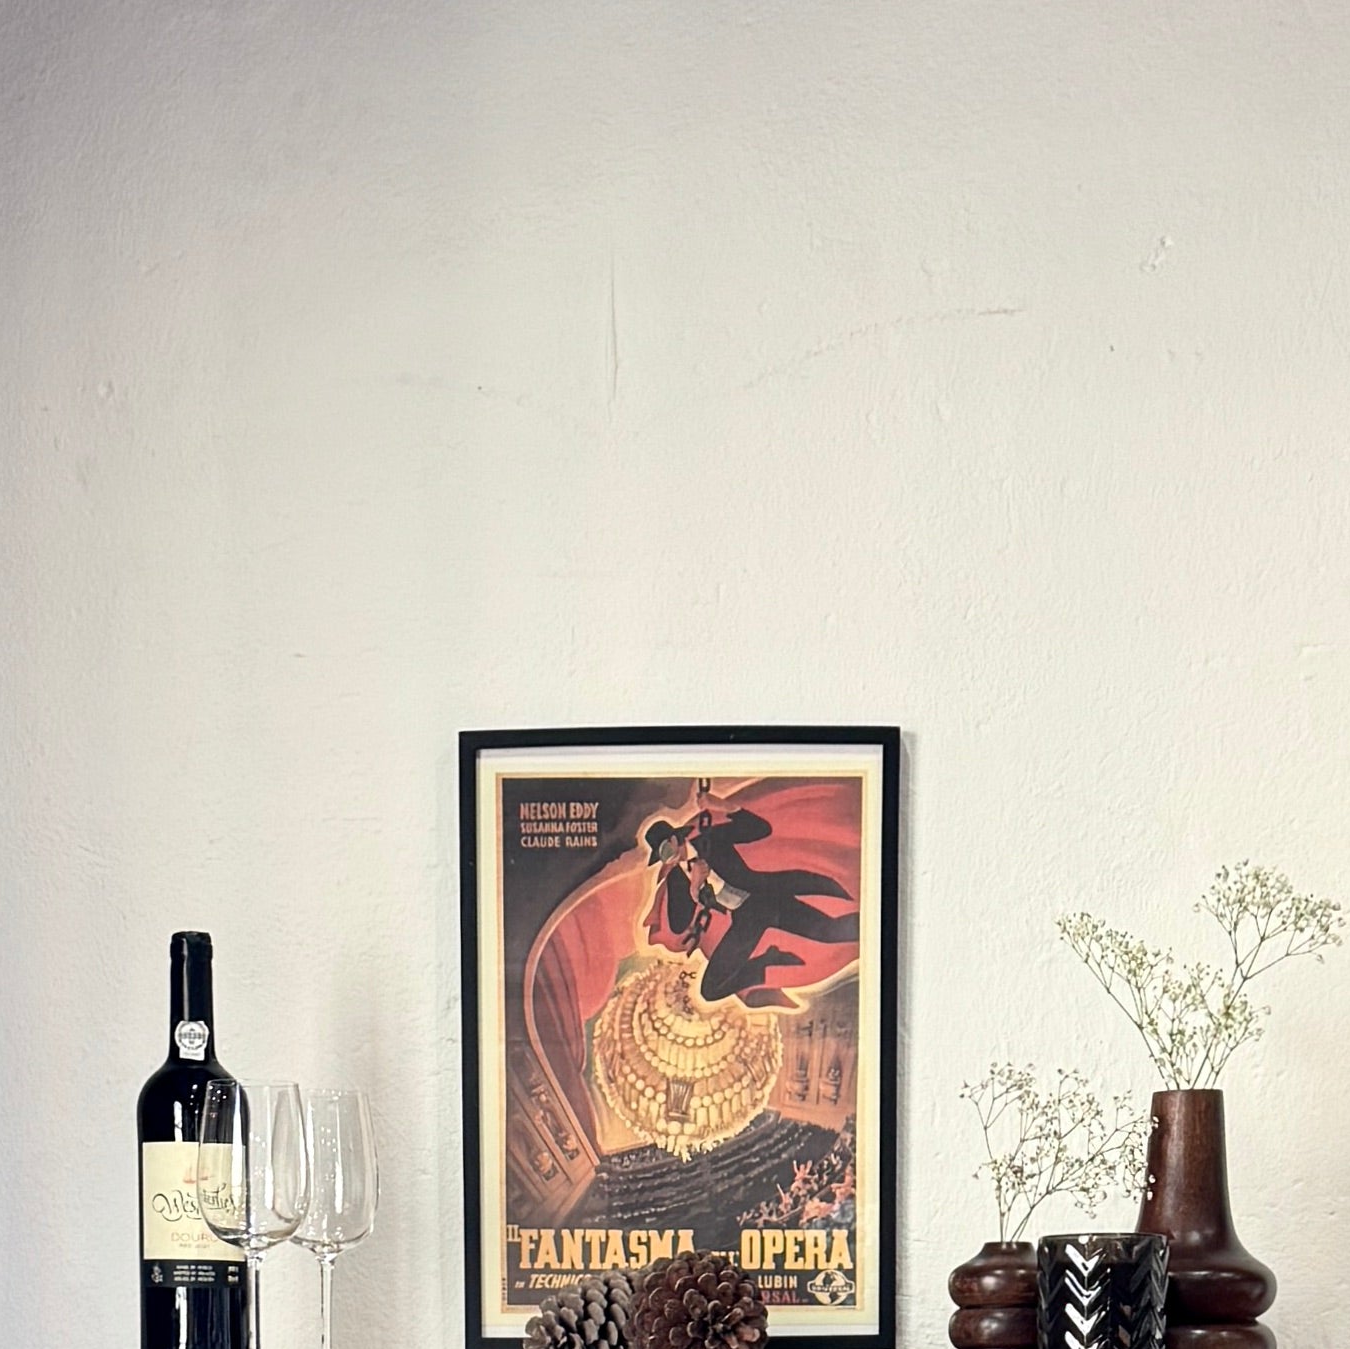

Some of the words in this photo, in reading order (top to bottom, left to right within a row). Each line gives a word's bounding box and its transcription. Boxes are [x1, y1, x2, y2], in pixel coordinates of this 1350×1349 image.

[519, 801, 567, 820] NELSON
[569, 801, 600, 820] EDDY
[520, 821, 565, 834] SUSANNA
[565, 821, 598, 834] FOSTER
[520, 836, 561, 848] CLAUDE
[565, 836, 598, 848] RAINS
[506, 1224, 521, 1242] IL
[518, 1228, 697, 1271] FANTASMA
[740, 1228, 854, 1270] OPERA
[757, 1274, 798, 1289] LUBIN
